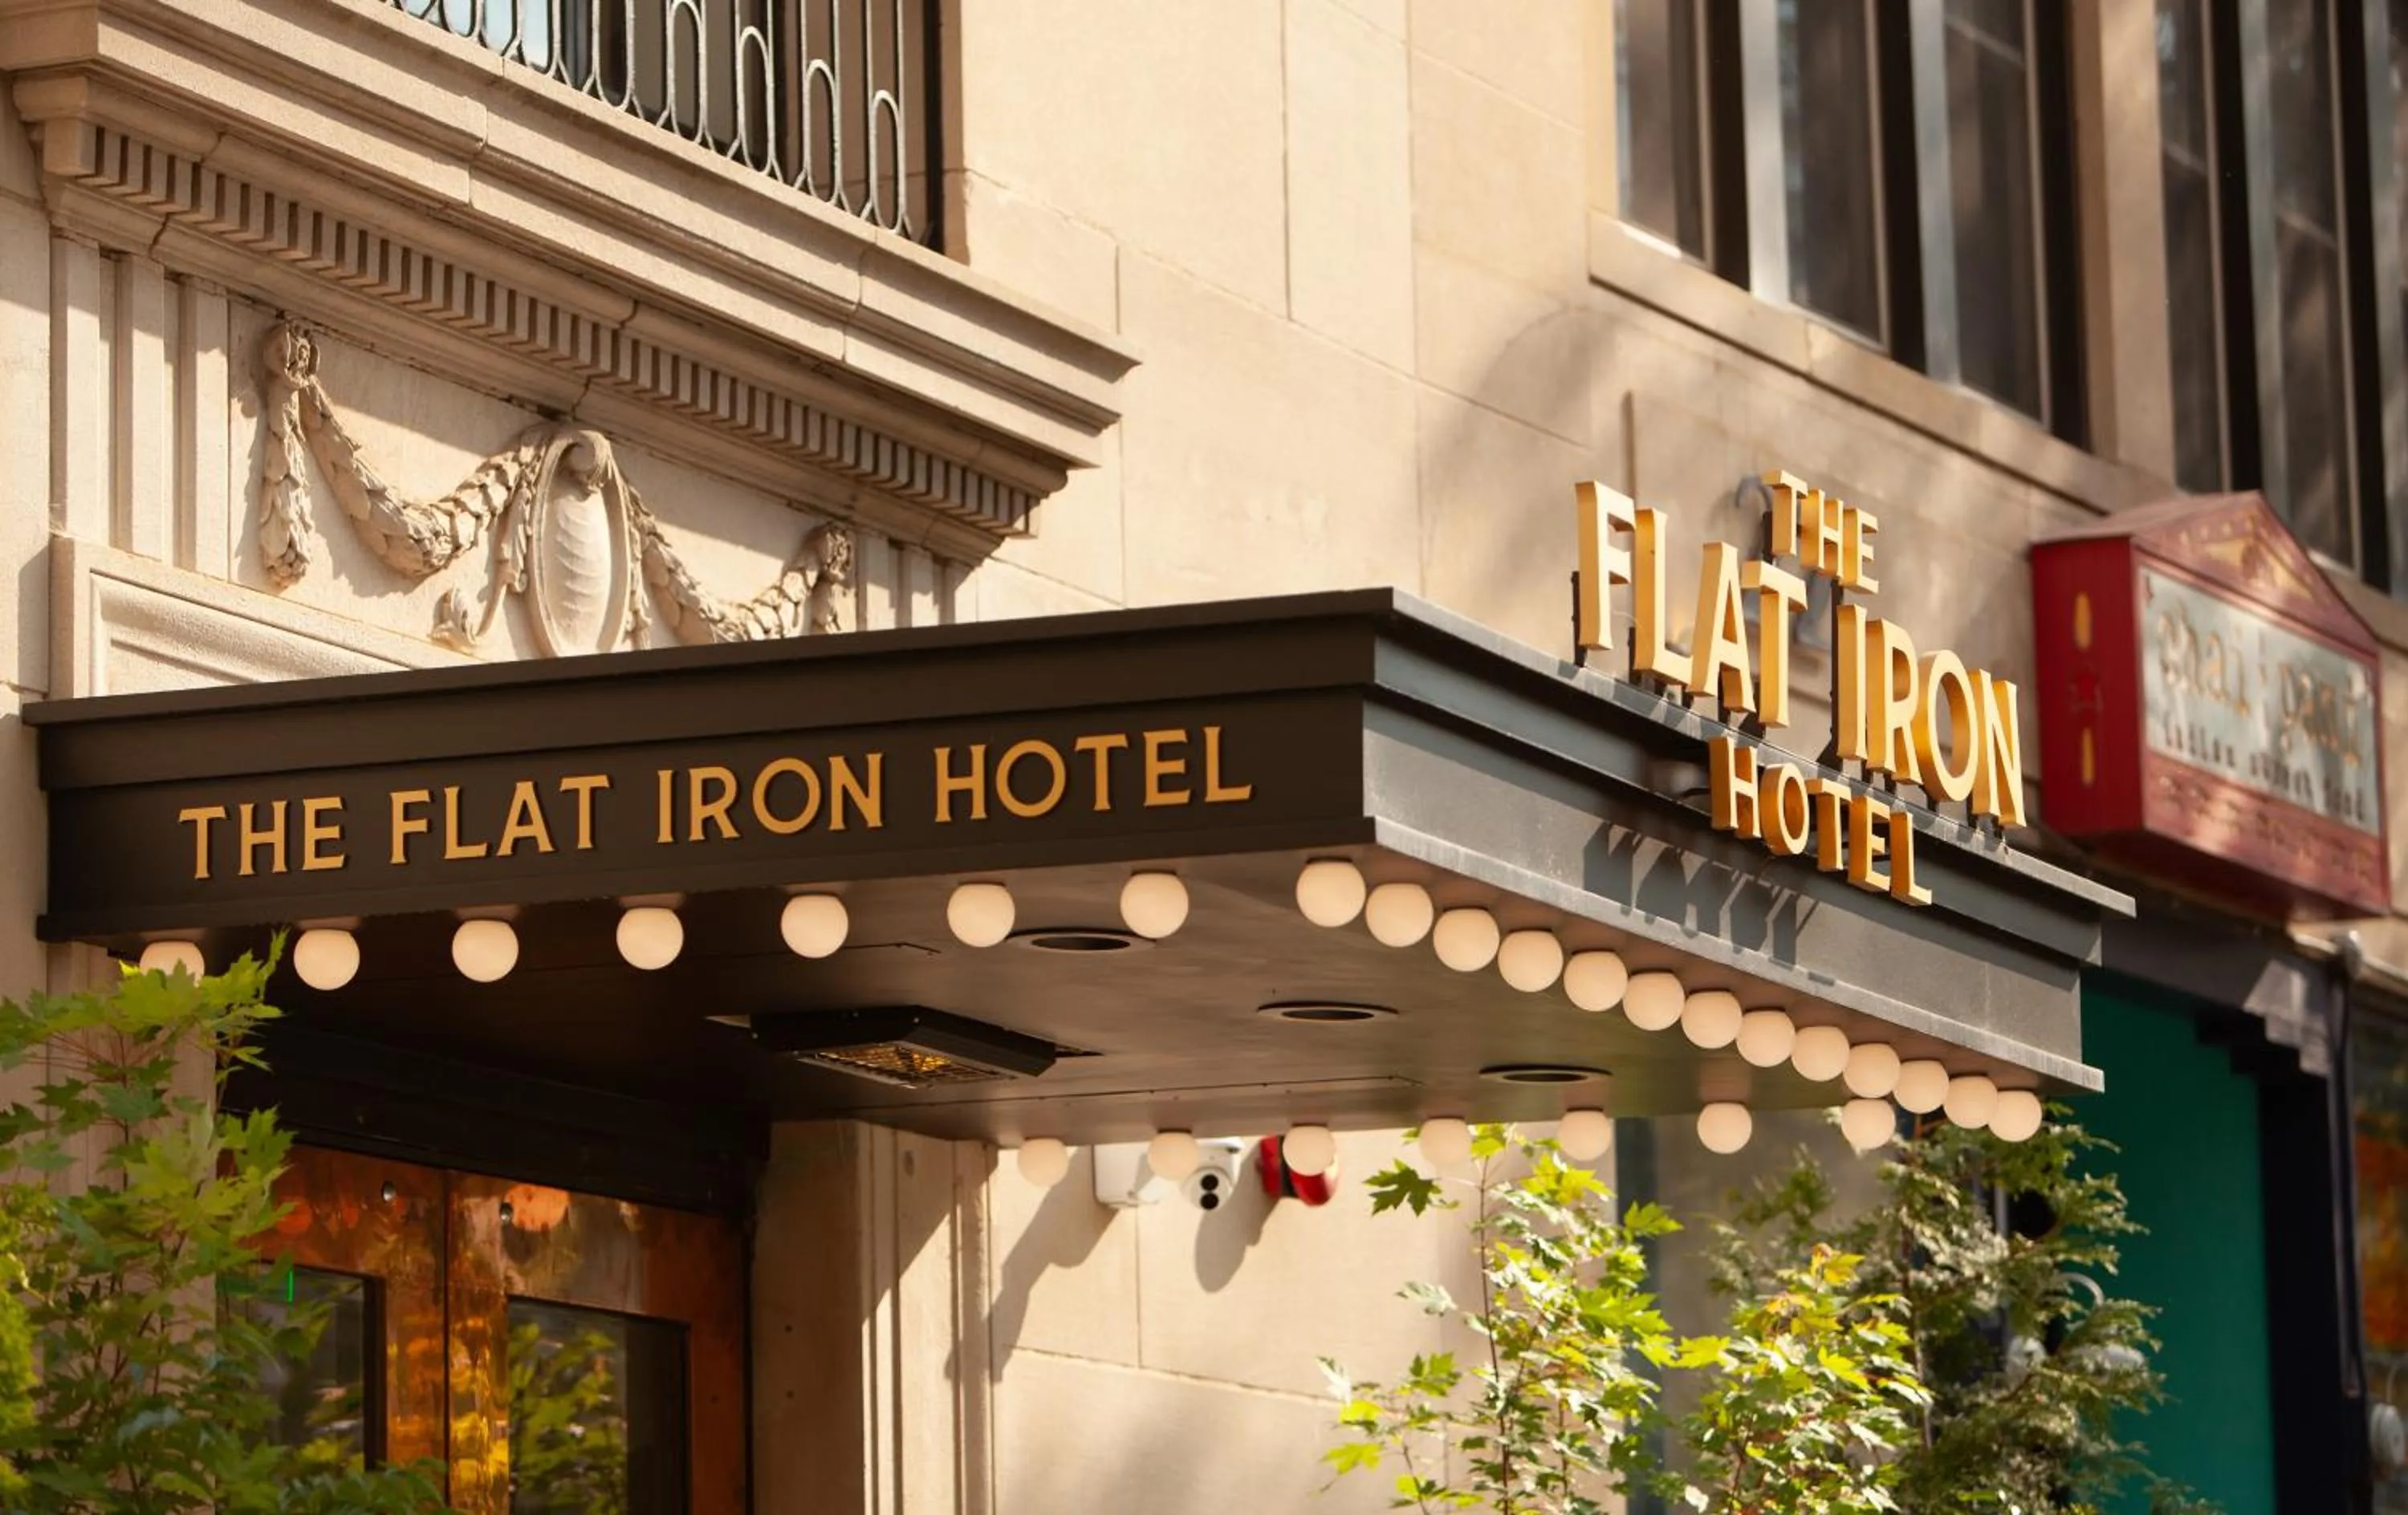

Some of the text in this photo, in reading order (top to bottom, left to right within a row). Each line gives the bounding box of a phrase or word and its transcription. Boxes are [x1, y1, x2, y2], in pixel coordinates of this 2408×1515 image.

[1769, 469, 1879, 594] THE
[1575, 480, 1808, 729] FLAT
[1837, 603, 2027, 828] IRON
[178, 726, 1252, 879] THE FLAT IRON HOTEL
[1708, 736, 1933, 906] HOTEL
